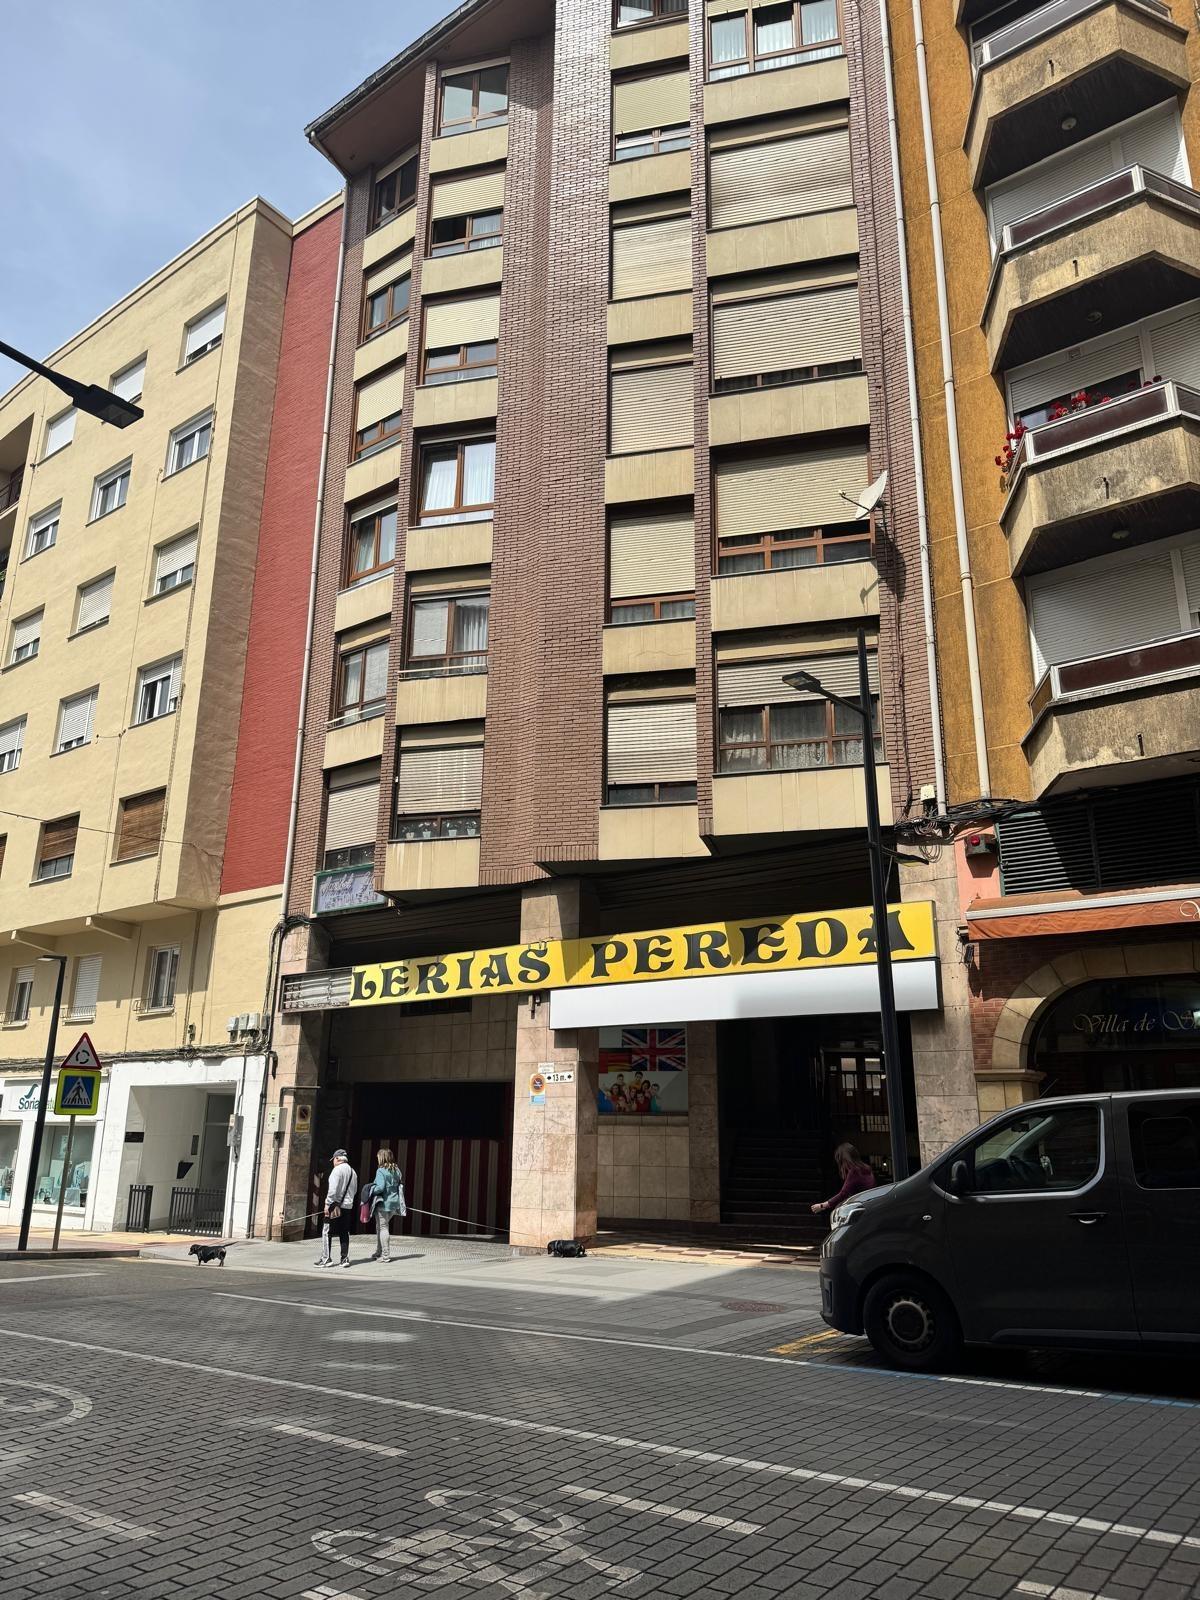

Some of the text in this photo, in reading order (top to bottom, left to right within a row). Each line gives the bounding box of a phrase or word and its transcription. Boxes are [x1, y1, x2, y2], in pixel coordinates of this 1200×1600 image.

[350, 909, 915, 1001] LERIAS PEREDA
[1073, 1013, 1129, 1033] Villa
[1134, 1012, 1156, 1032] de
[18, 1097, 41, 1110] Soria
